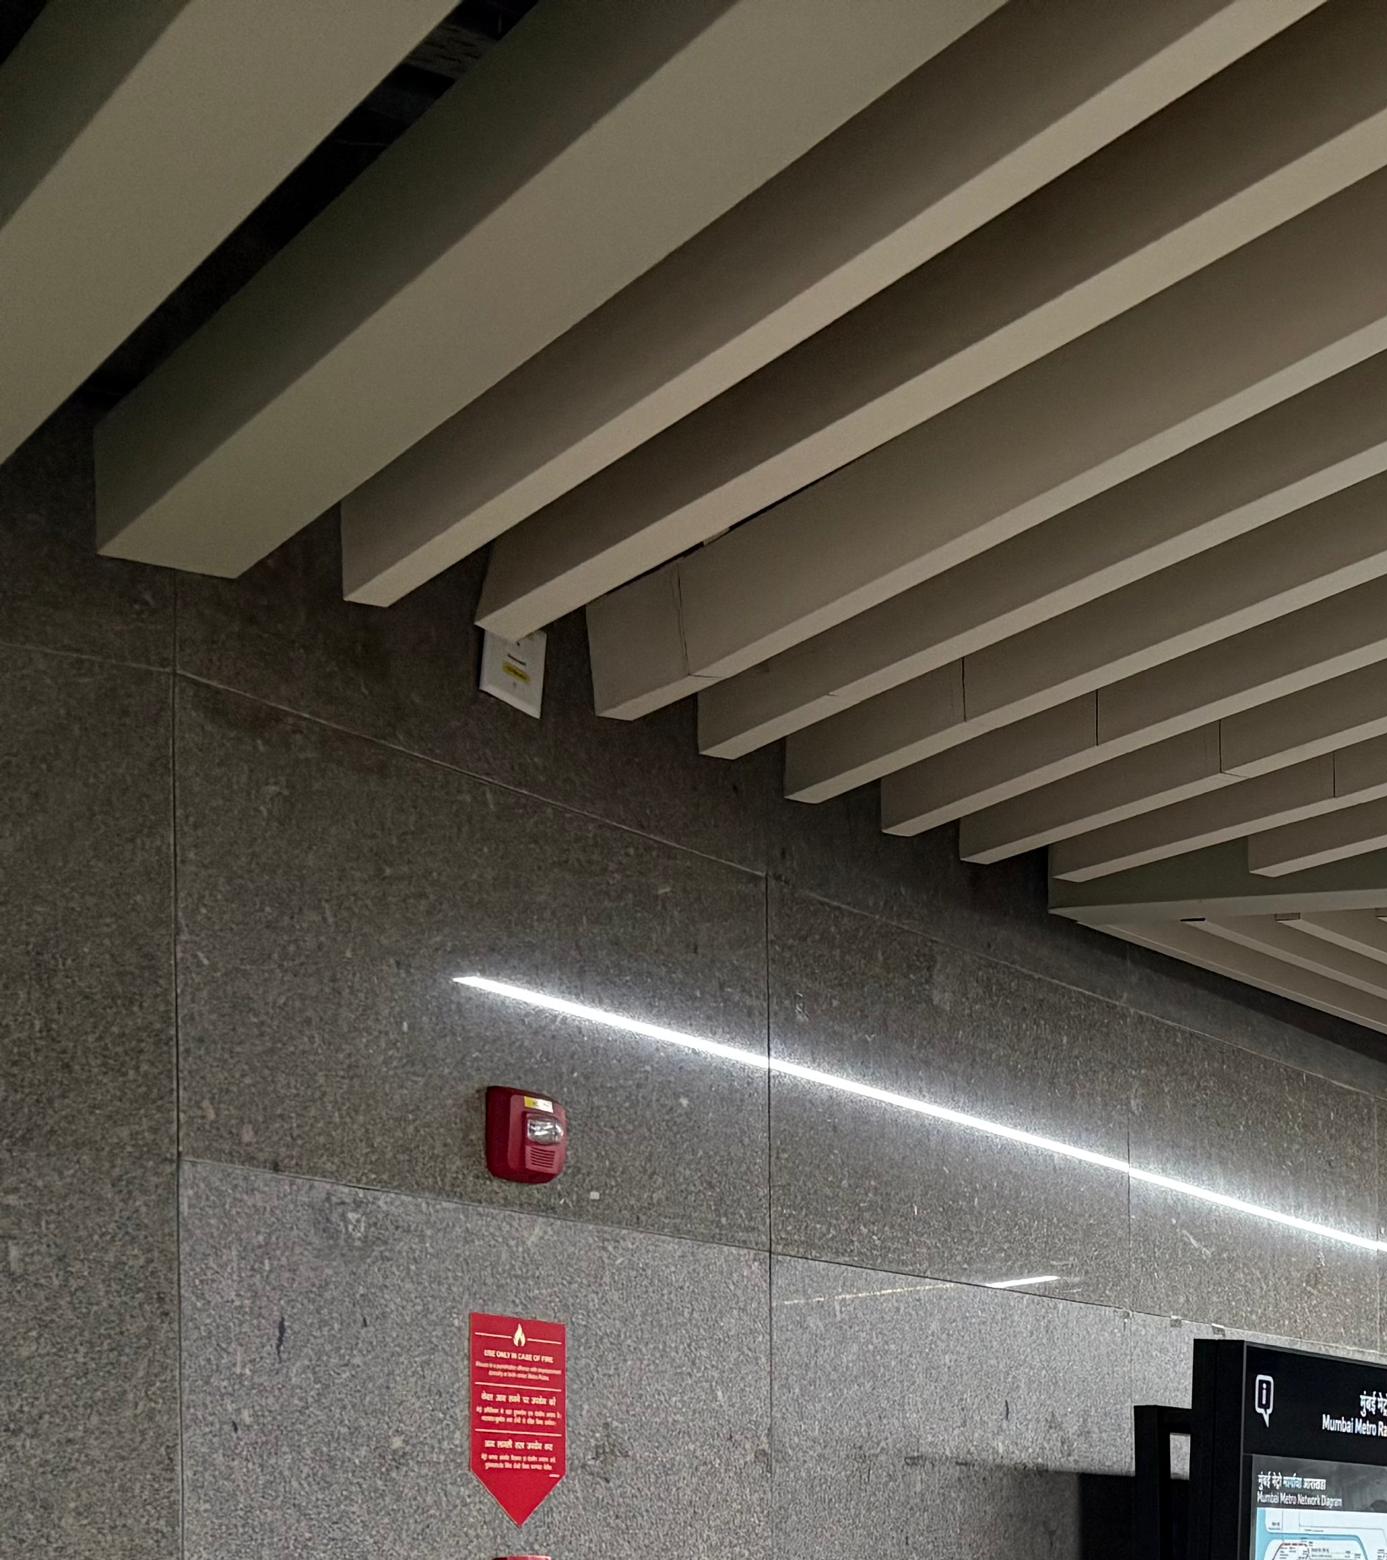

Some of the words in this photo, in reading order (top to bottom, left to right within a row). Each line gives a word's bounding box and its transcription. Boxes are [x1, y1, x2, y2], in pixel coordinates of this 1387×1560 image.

[1322, 1414, 1353, 1434] Mumbai
[1355, 1418, 1377, 1436] Metro
[1257, 1490, 1279, 1504] Mumbai
[1280, 1492, 1297, 1505] Metro
[1297, 1493, 1320, 1506] Network
[1320, 1494, 1343, 1508] Diagram
